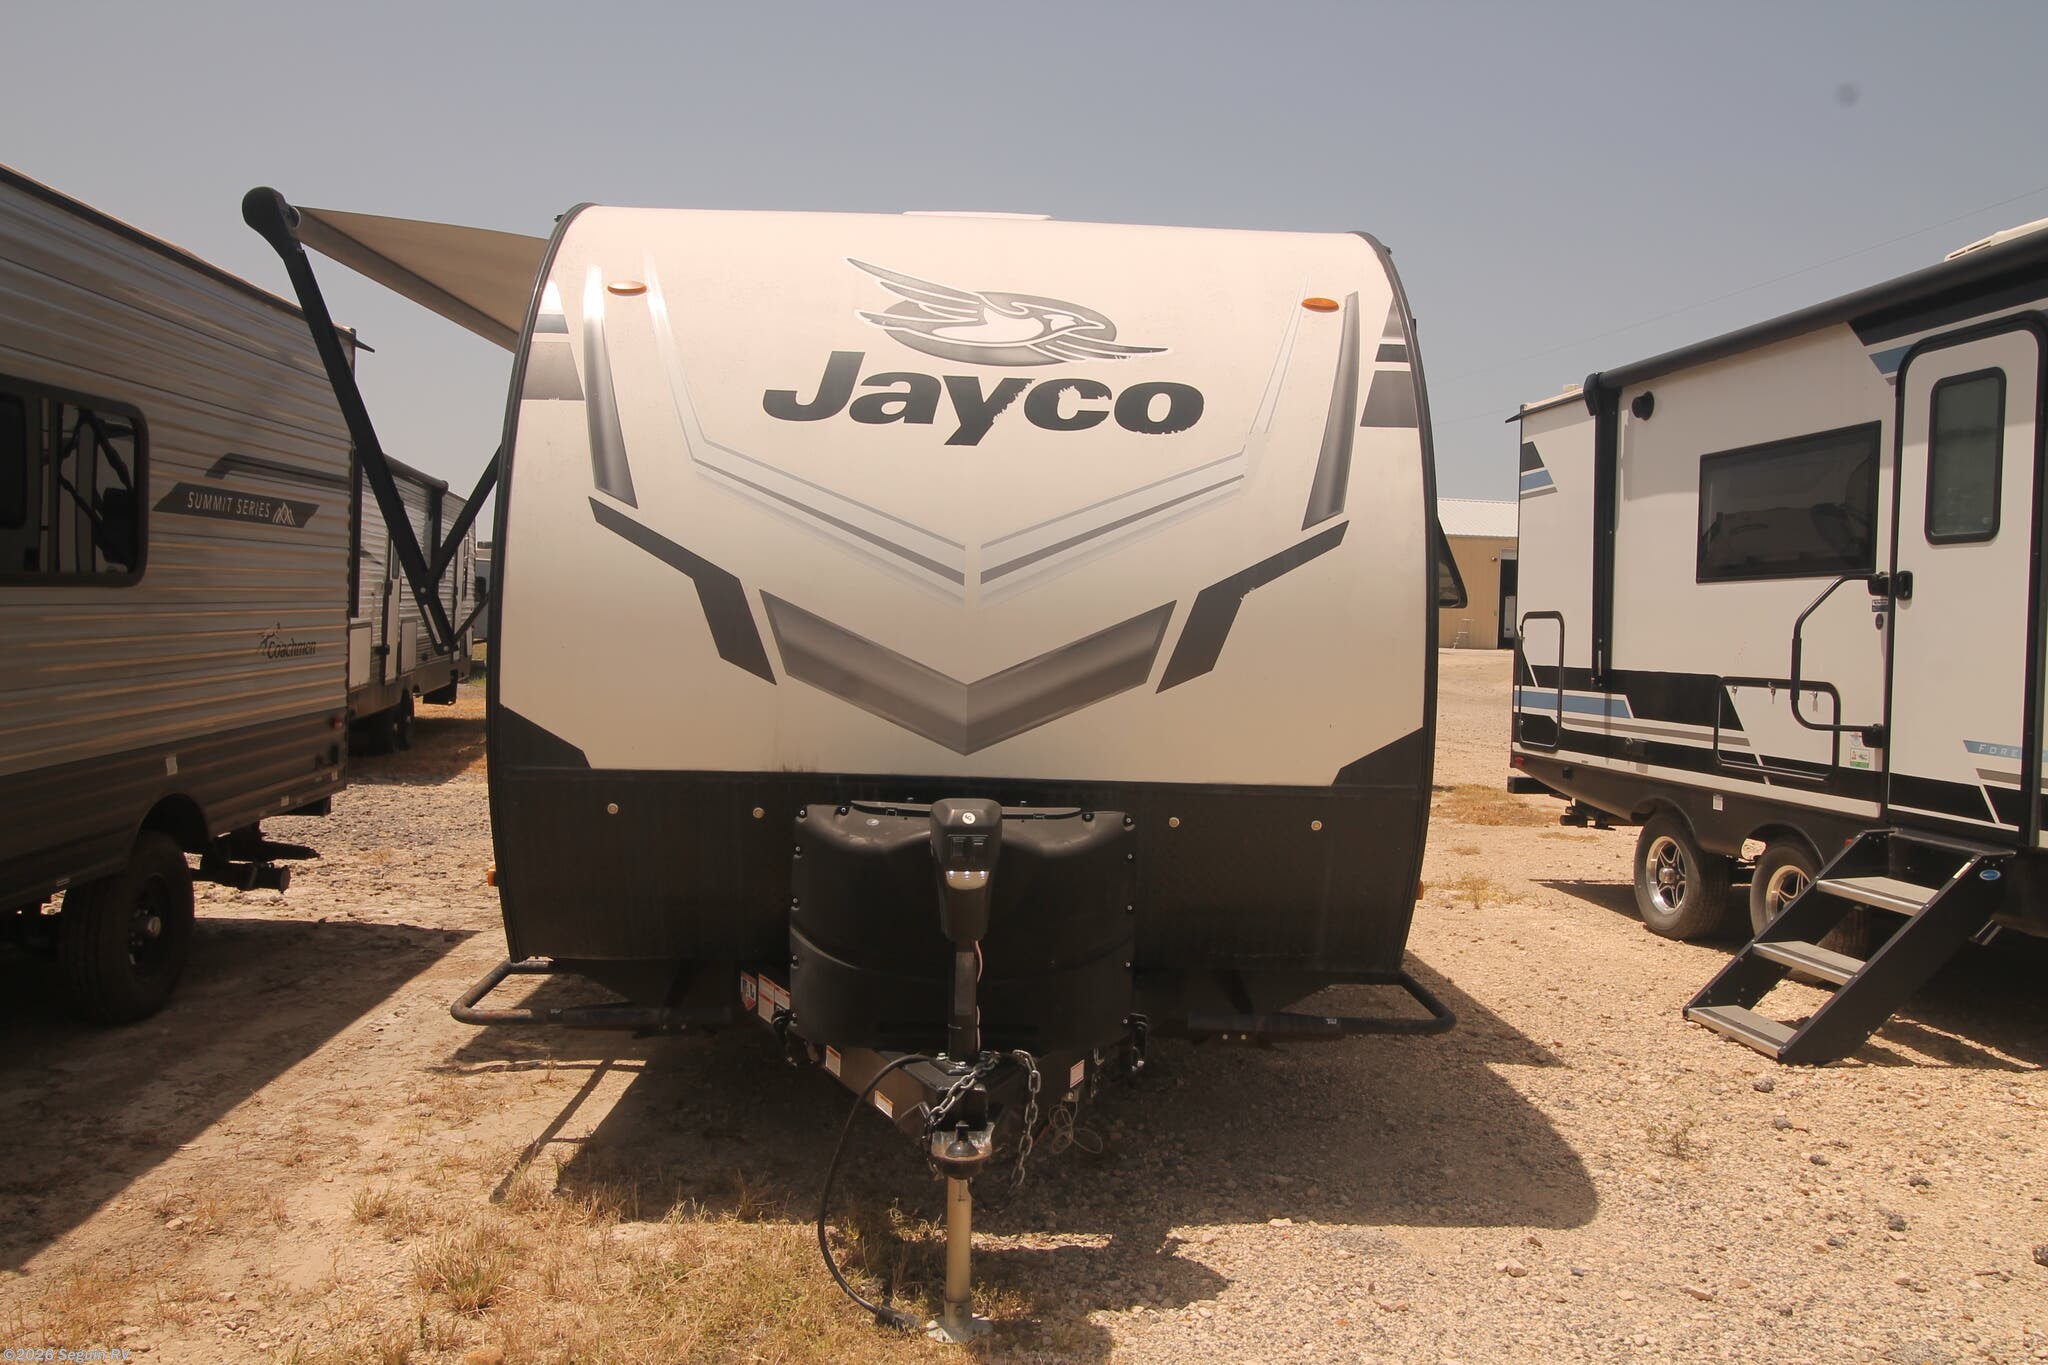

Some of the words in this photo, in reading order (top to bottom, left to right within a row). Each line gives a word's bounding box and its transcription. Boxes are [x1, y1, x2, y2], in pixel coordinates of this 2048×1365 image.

[763, 351, 1205, 446] Jayco
[187, 491, 233, 513] SUMMIT
[236, 498, 271, 518] SERIES
[1979, 743, 2019, 758] FORE
